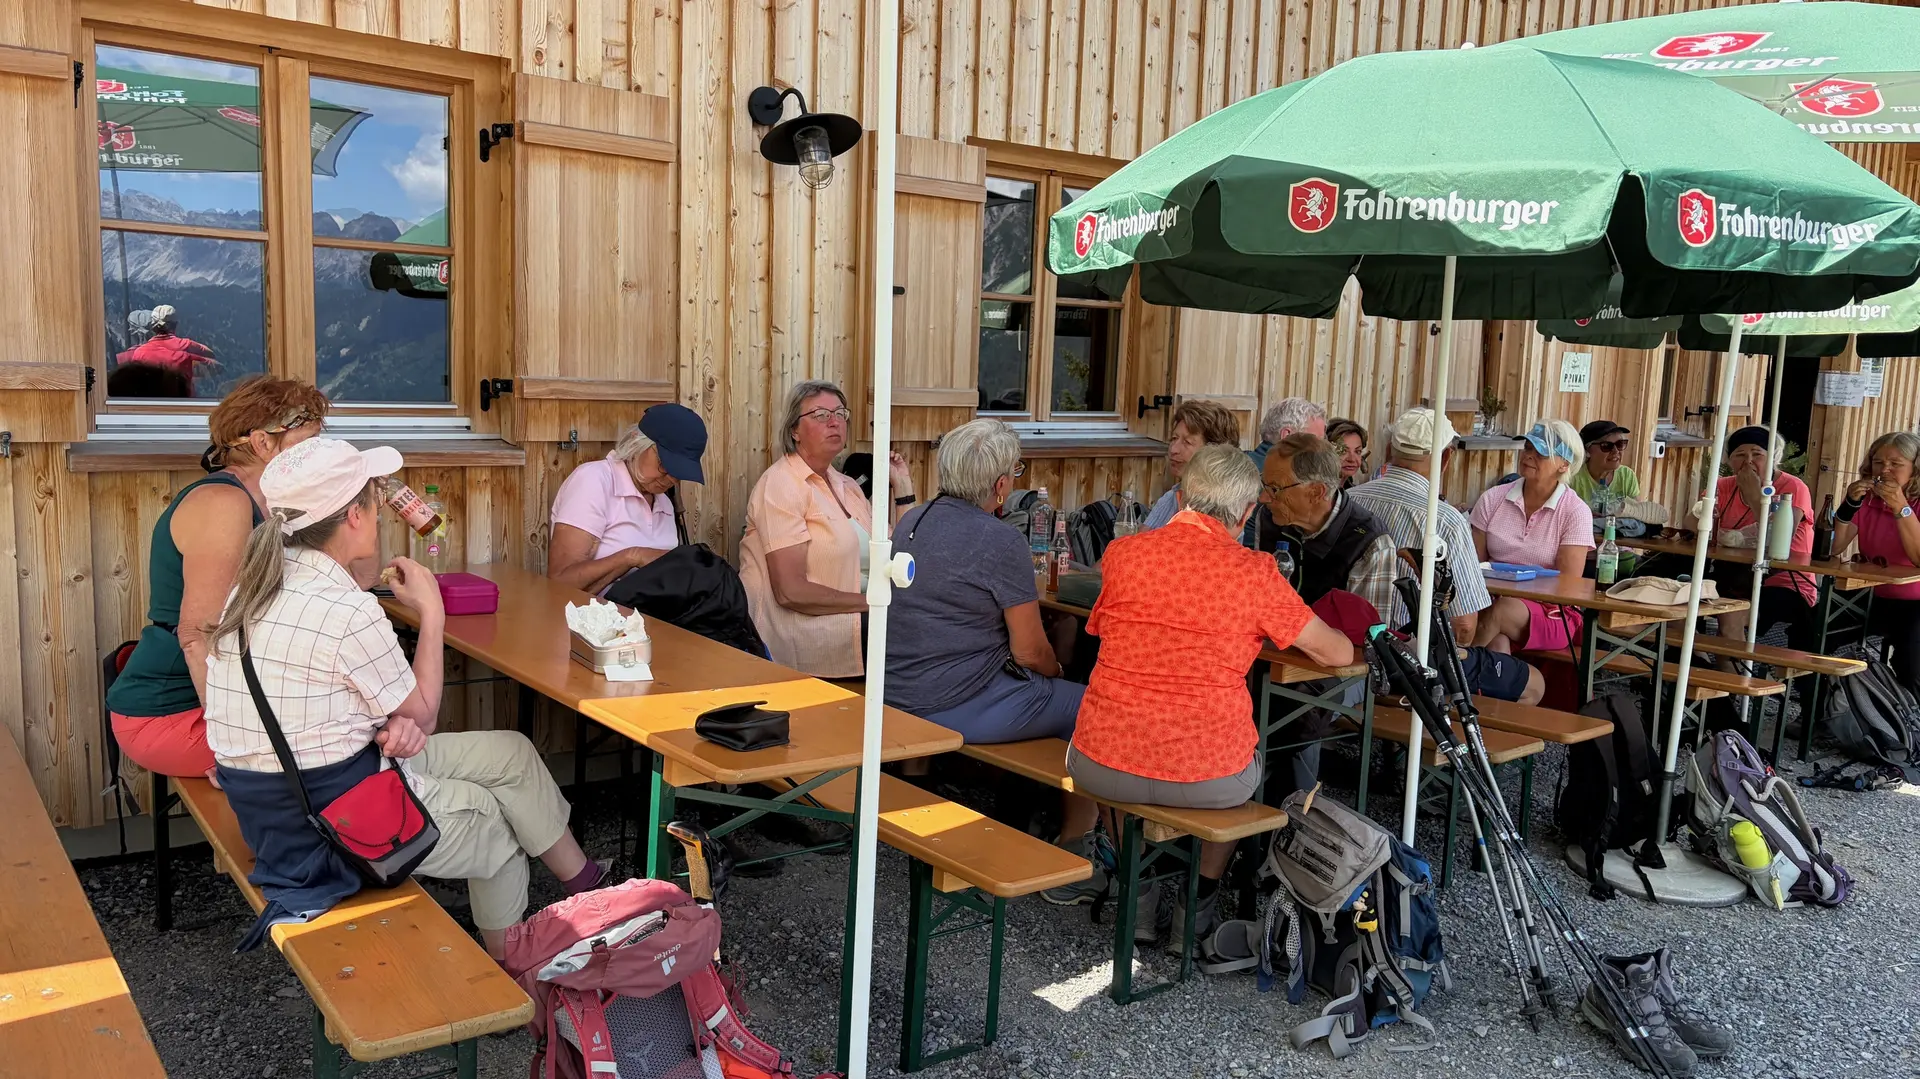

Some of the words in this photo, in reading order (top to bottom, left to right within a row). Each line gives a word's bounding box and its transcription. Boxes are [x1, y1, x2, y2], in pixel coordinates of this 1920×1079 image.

[1097, 205, 1180, 243] Fohrenburger
[1343, 188, 1560, 231] Fohrenburger
[1718, 203, 1879, 250] Fohrenburger
[653, 943, 682, 962] deuter
